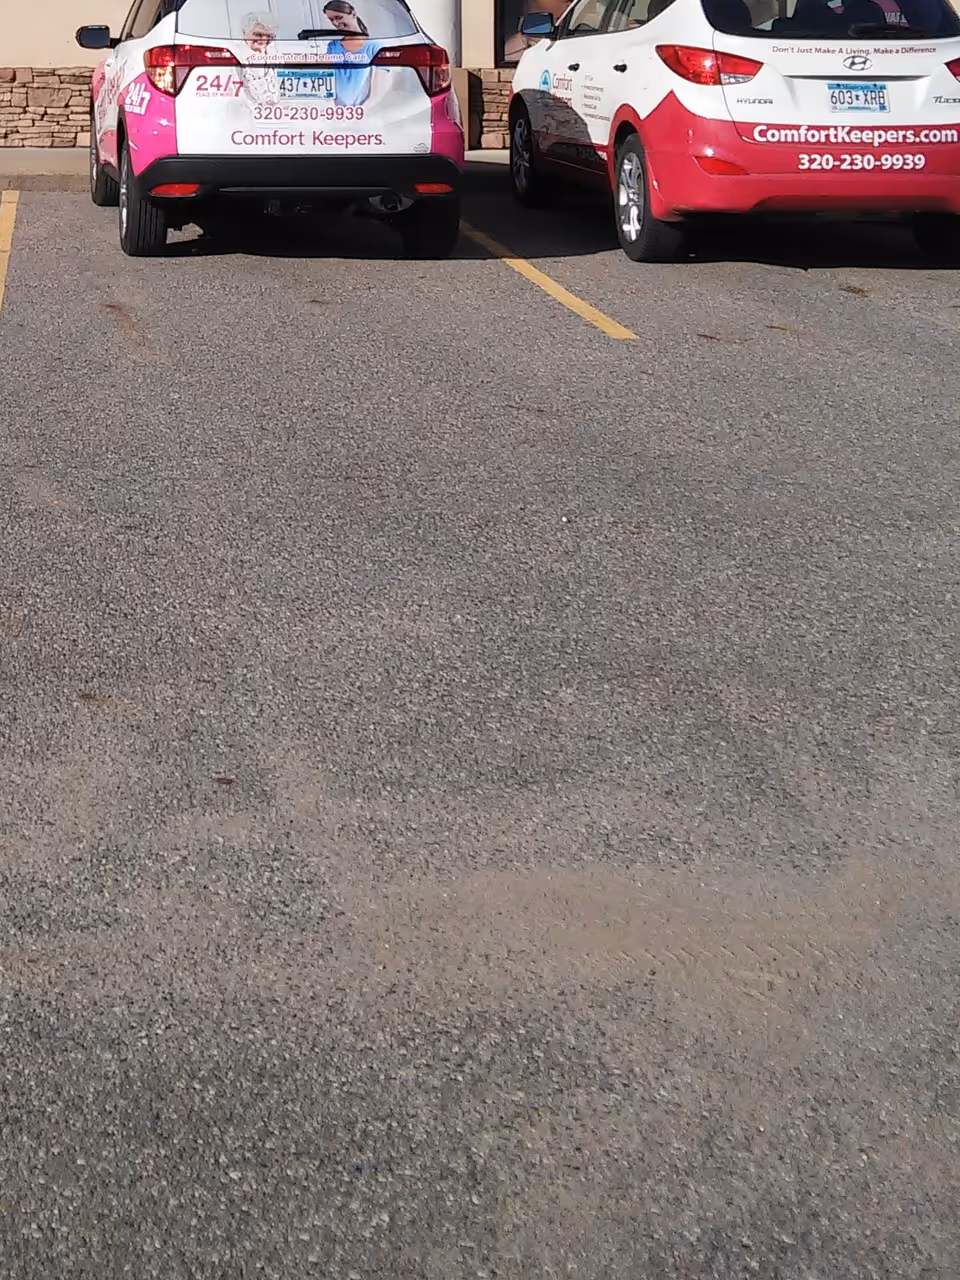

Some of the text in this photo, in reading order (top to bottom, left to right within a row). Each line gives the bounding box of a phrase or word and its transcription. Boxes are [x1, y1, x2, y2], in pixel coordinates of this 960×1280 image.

[250, 53, 306, 62] Coordinated
[318, 53, 345, 62] Home
[345, 52, 367, 62] Care
[772, 45, 795, 54] Don't
[796, 46, 813, 54] Just
[814, 47, 837, 55] Make
[837, 47, 844, 55] A
[873, 47, 895, 55] Make
[900, 46, 937, 54] Difference
[195, 74, 244, 97] 24/7
[279, 76, 333, 93] 437 XPU
[125, 81, 151, 116] 24/7
[830, 89, 886, 105] 603 XRB
[253, 106, 365, 121] 320-230-9939
[231, 129, 305, 146] Comfort
[752, 124, 959, 148] ComfortKeepers.com
[797, 153, 927, 170] 320-230-9939
